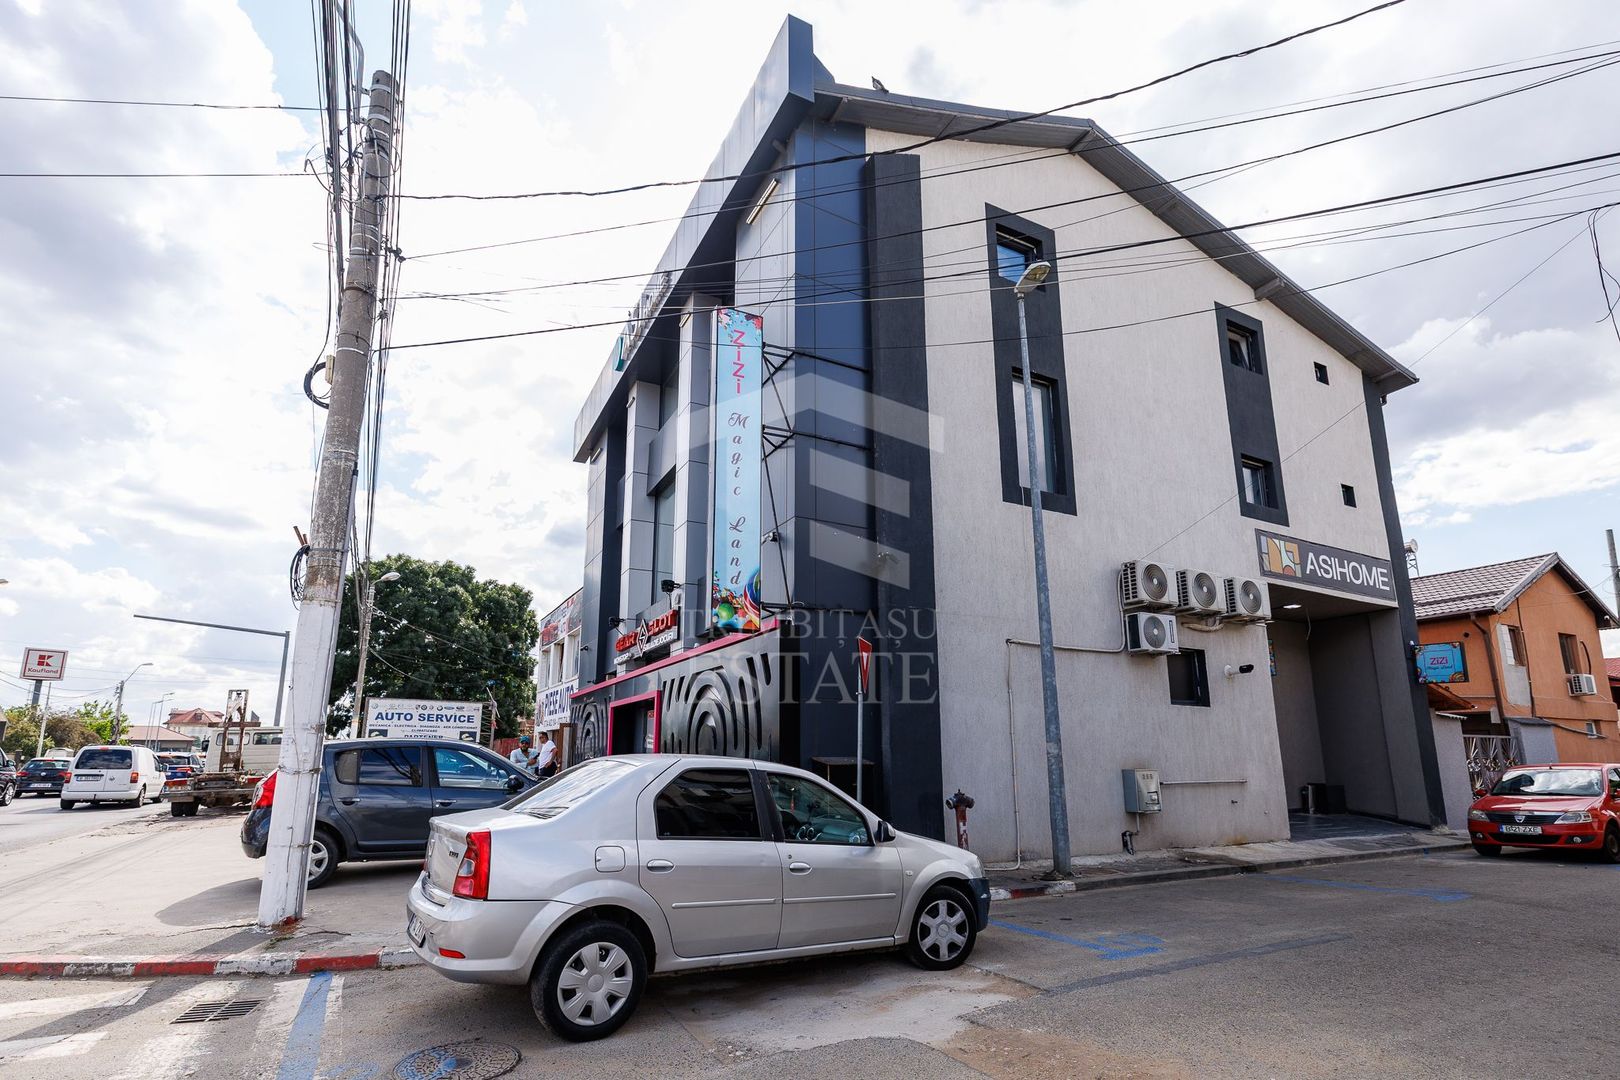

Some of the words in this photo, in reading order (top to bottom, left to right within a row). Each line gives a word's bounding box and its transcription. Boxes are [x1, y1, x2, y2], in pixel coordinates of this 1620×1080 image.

[728, 412, 749, 496] Magic
[729, 516, 746, 585] Land
[1306, 552, 1390, 591] ASIHOME
[375, 712, 414, 722] AUTO
[418, 713, 475, 724] SERVICE
